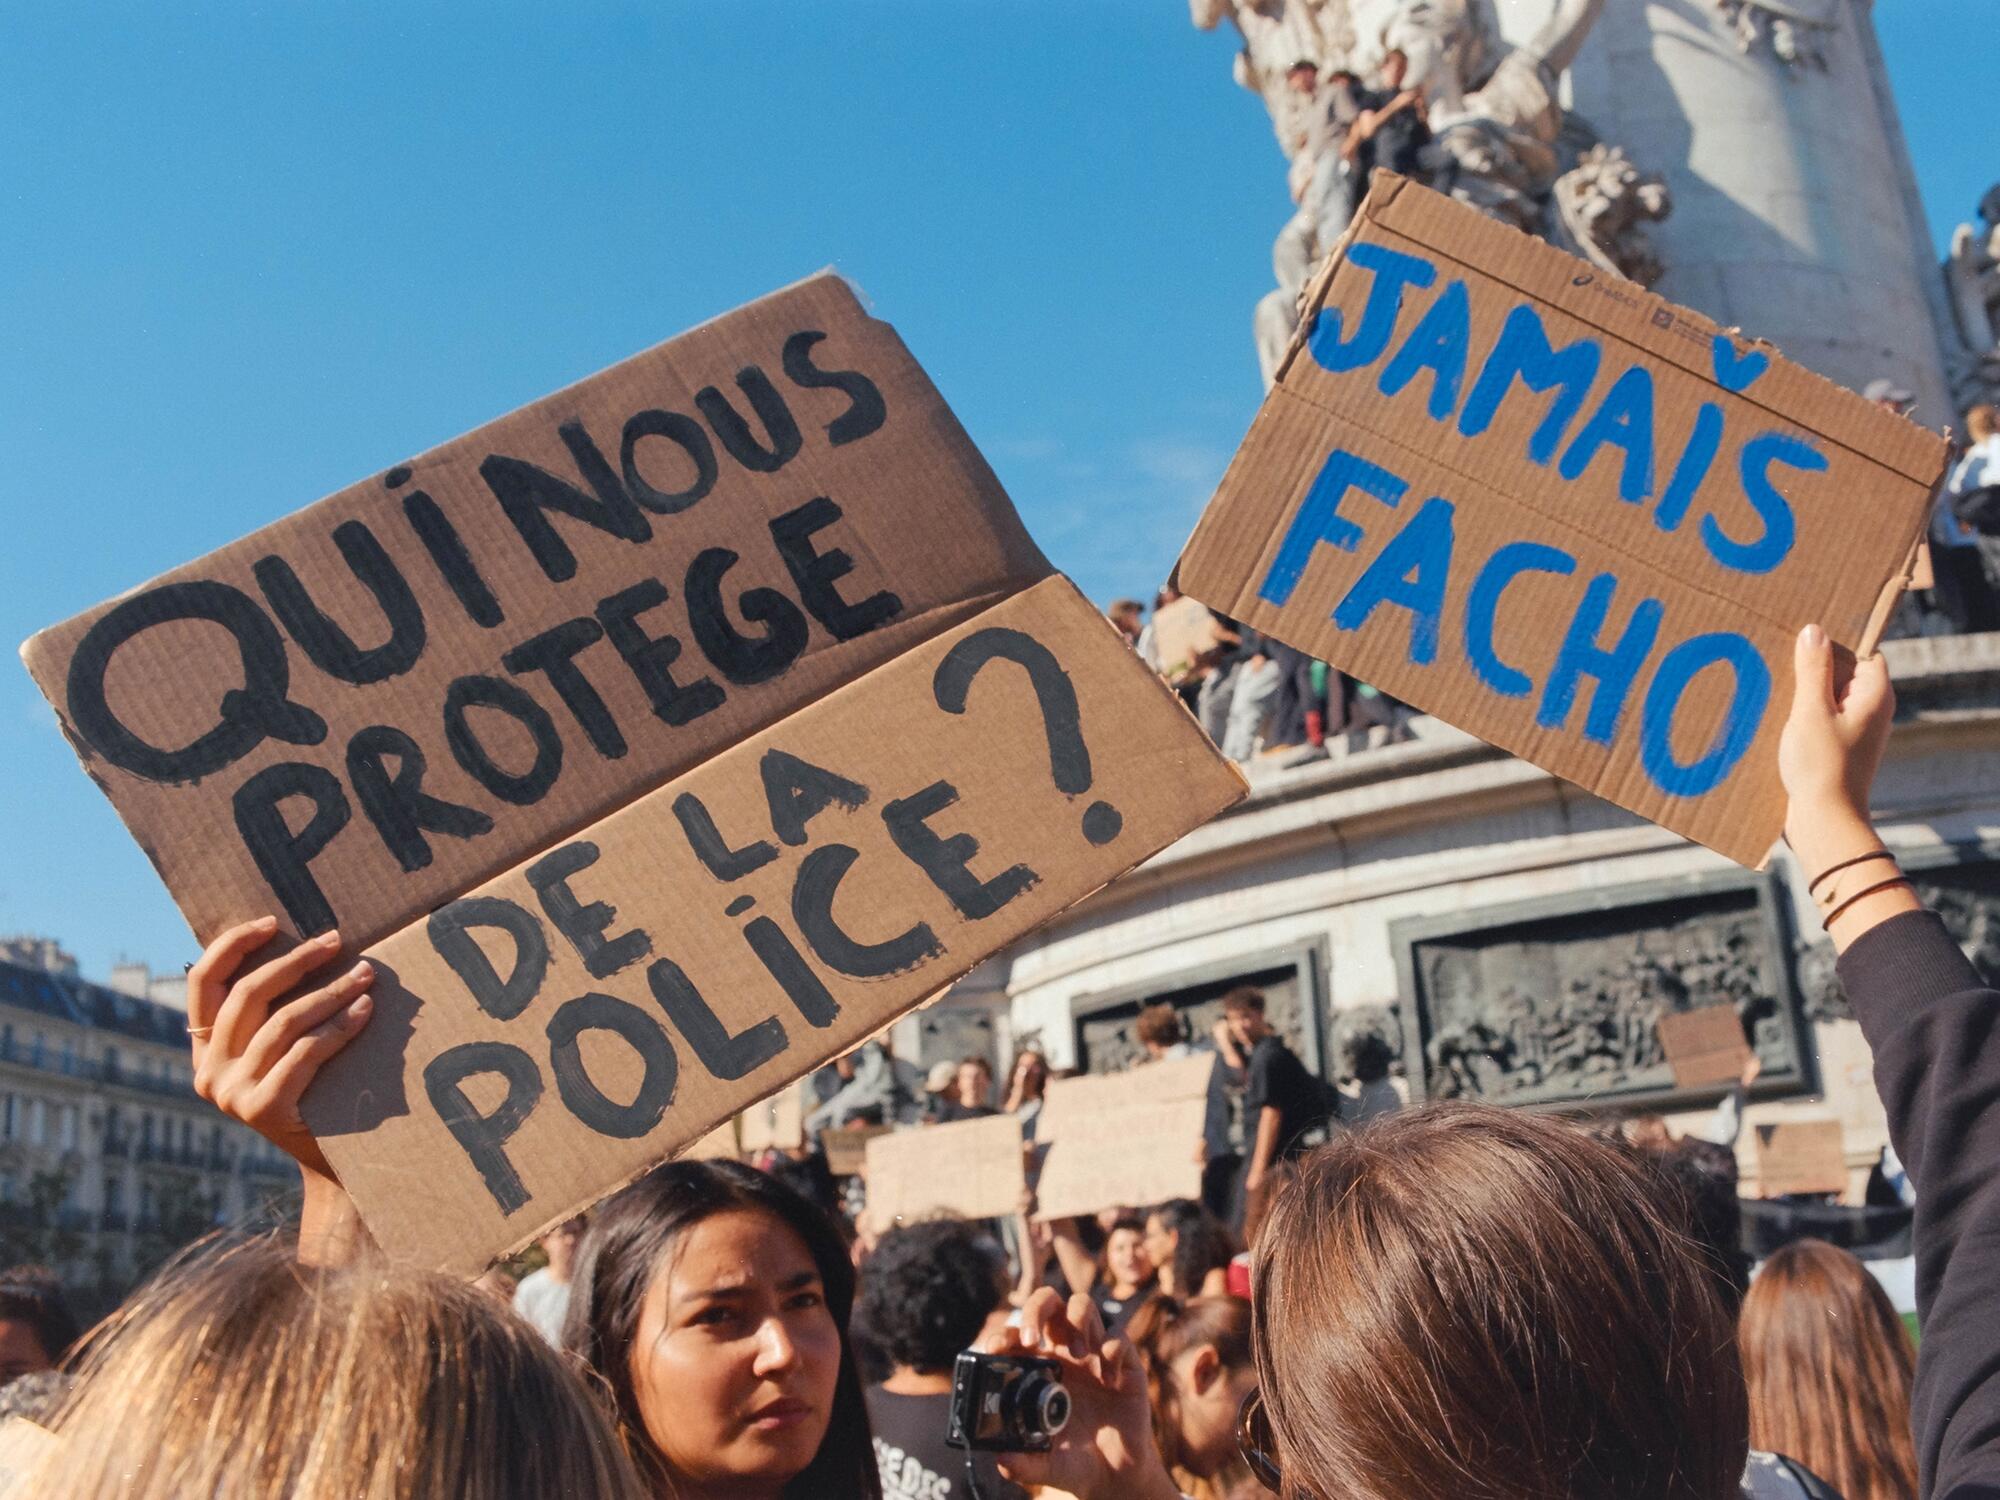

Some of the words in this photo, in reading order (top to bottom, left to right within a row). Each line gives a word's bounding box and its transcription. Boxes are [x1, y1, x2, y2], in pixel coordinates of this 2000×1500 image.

[479, 329, 888, 584] NOUS
[232, 496, 903, 940] PROTEGE
[1258, 450, 1771, 797] FACHO
[426, 841, 653, 1021] DE
[672, 748, 869, 883] LA
